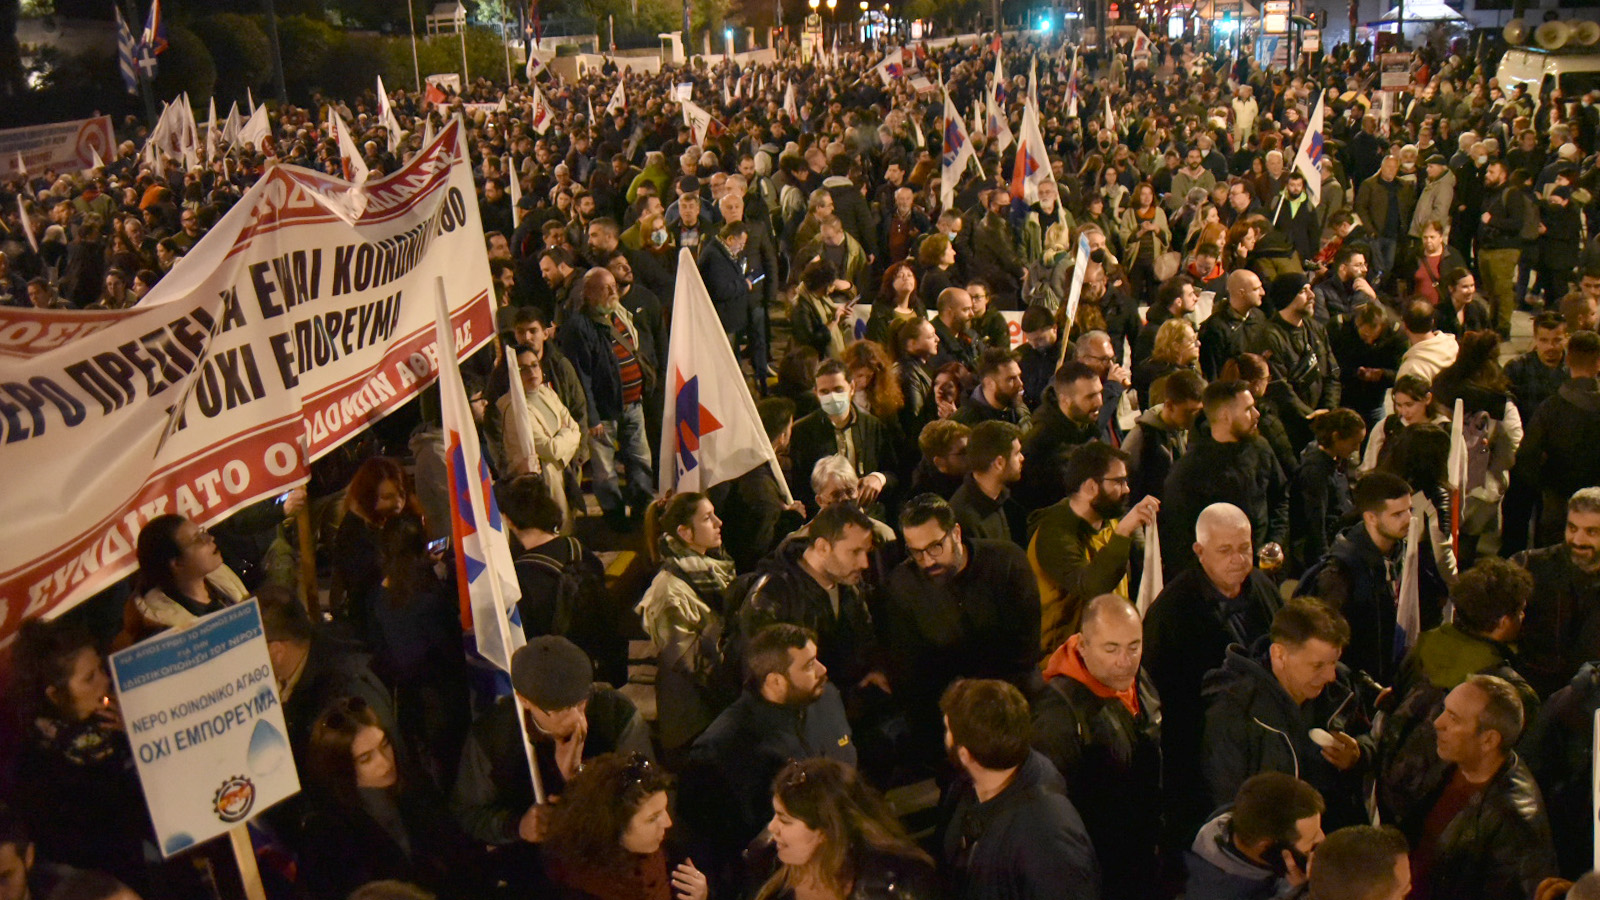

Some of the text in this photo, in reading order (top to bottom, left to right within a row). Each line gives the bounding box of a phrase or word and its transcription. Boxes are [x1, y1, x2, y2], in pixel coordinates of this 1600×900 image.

[196, 290, 402, 418] ΟΧΙ ΕΠΟΡΕΥΜΑ
[395, 319, 472, 389] ΑΘΗΑΣ
[0, 376, 87, 445] ΕΡΟ
[210, 641, 227, 655] ΤΟΥ
[228, 629, 259, 647] ΝΕΡΟΥ
[132, 664, 270, 734] ΝΕΡΟ ΚΟΙΝΩΝΙΚΟ ΑΓΑΘΟ
[140, 689, 279, 763] ΟΧΙ ΕΜΠΟΡΕΥΜΑ
